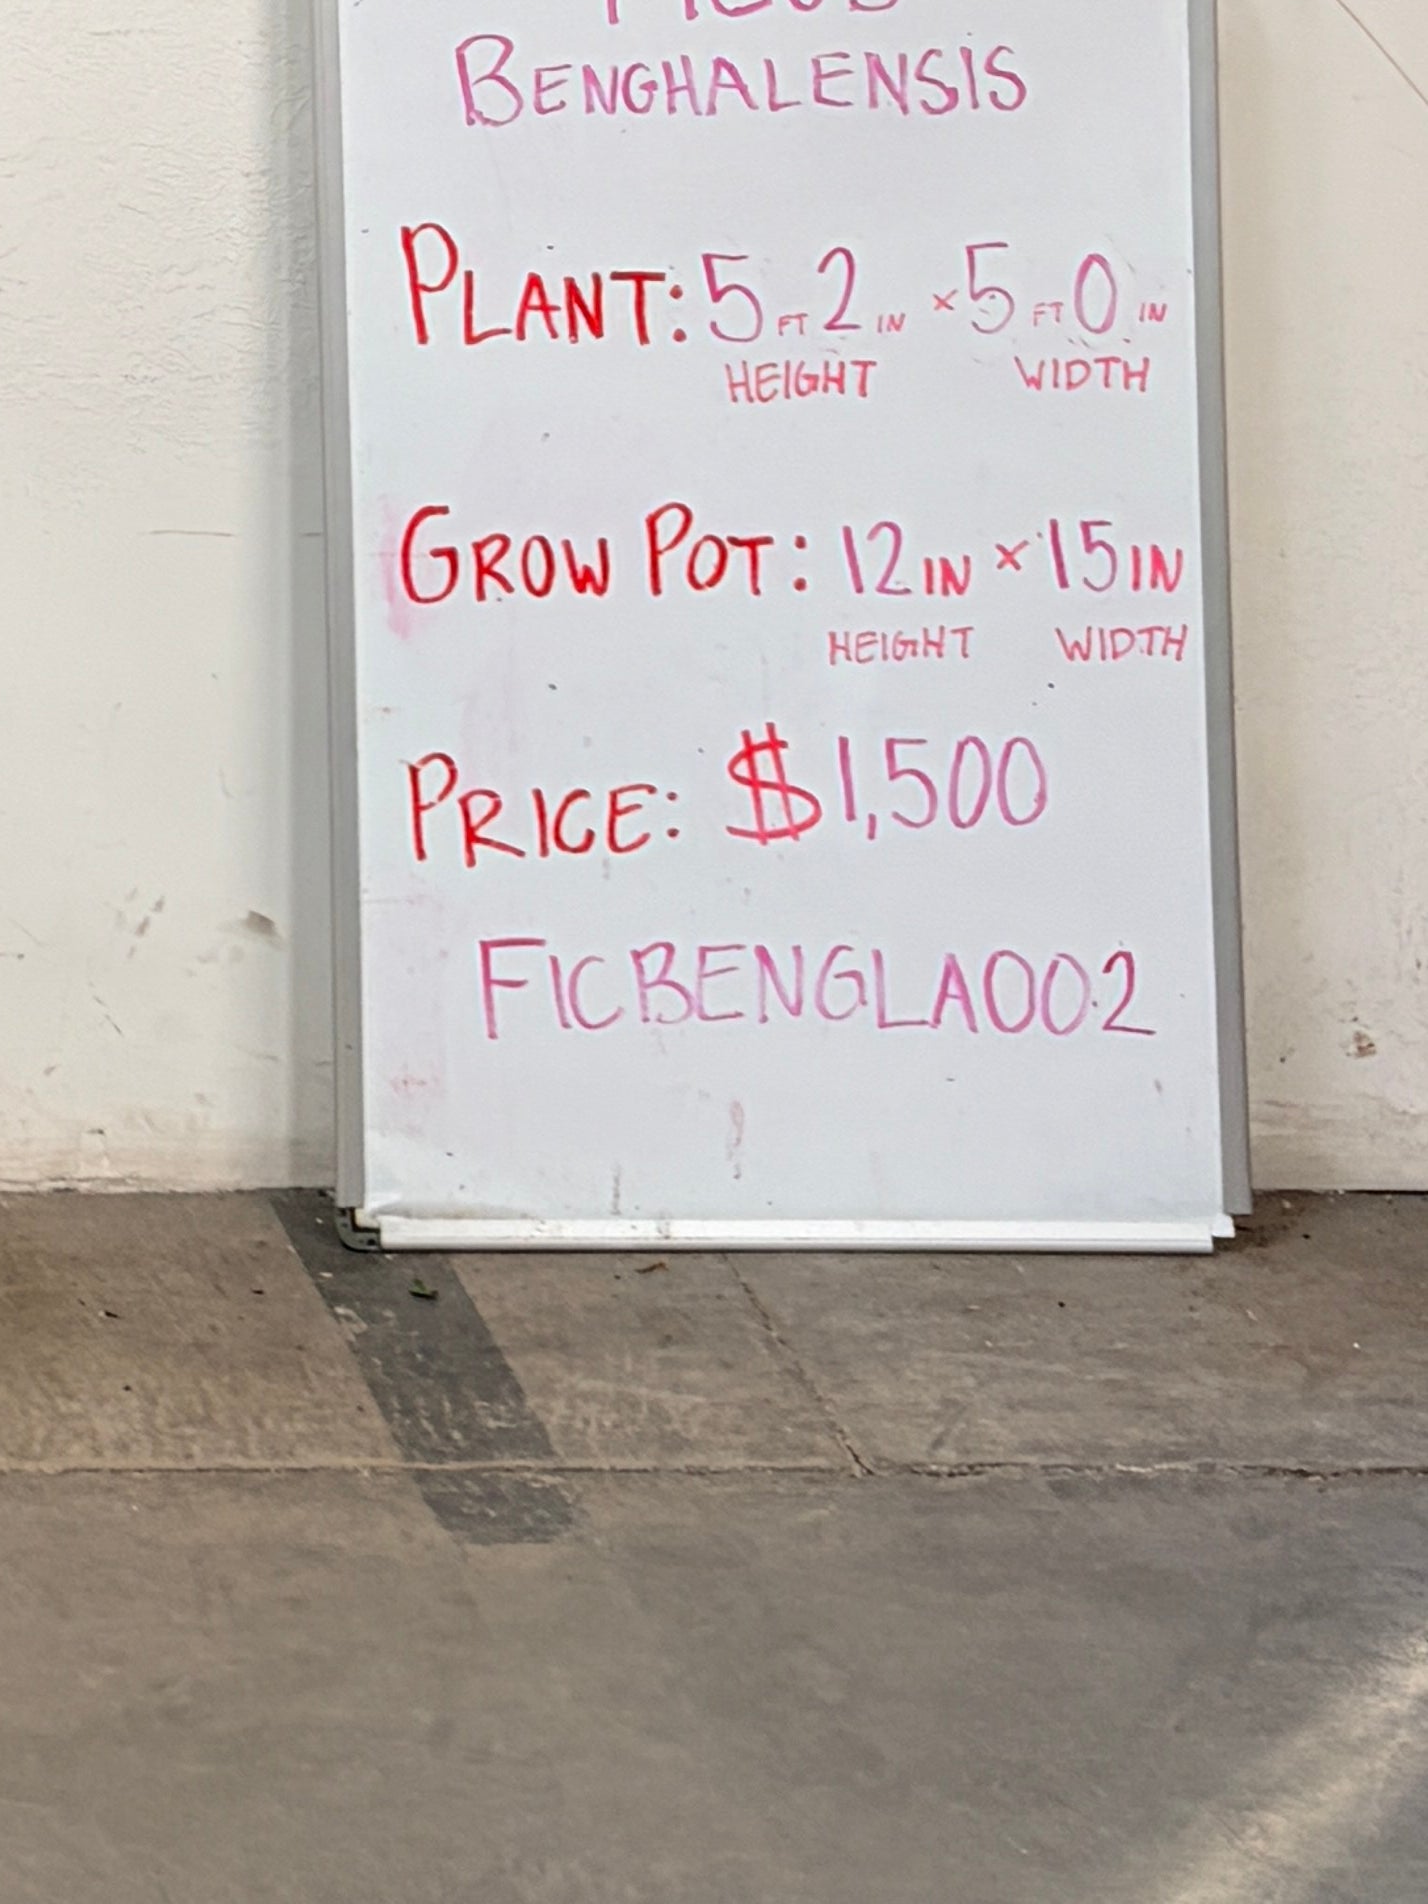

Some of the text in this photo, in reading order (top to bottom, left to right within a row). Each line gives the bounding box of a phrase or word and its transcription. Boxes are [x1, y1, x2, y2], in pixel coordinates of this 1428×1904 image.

[454, 34, 1027, 128] BENGHALENSIS
[399, 222, 687, 347] PLANT:
[725, 355, 1150, 404] HEIGHT WIDTH
[400, 504, 612, 605] GROW
[643, 501, 808, 599] POT:
[828, 625, 1188, 665] HEIGHT WIDTH
[406, 721, 1048, 870] PRICE: $1,500
[478, 937, 1153, 1041] FICBENGLA002
